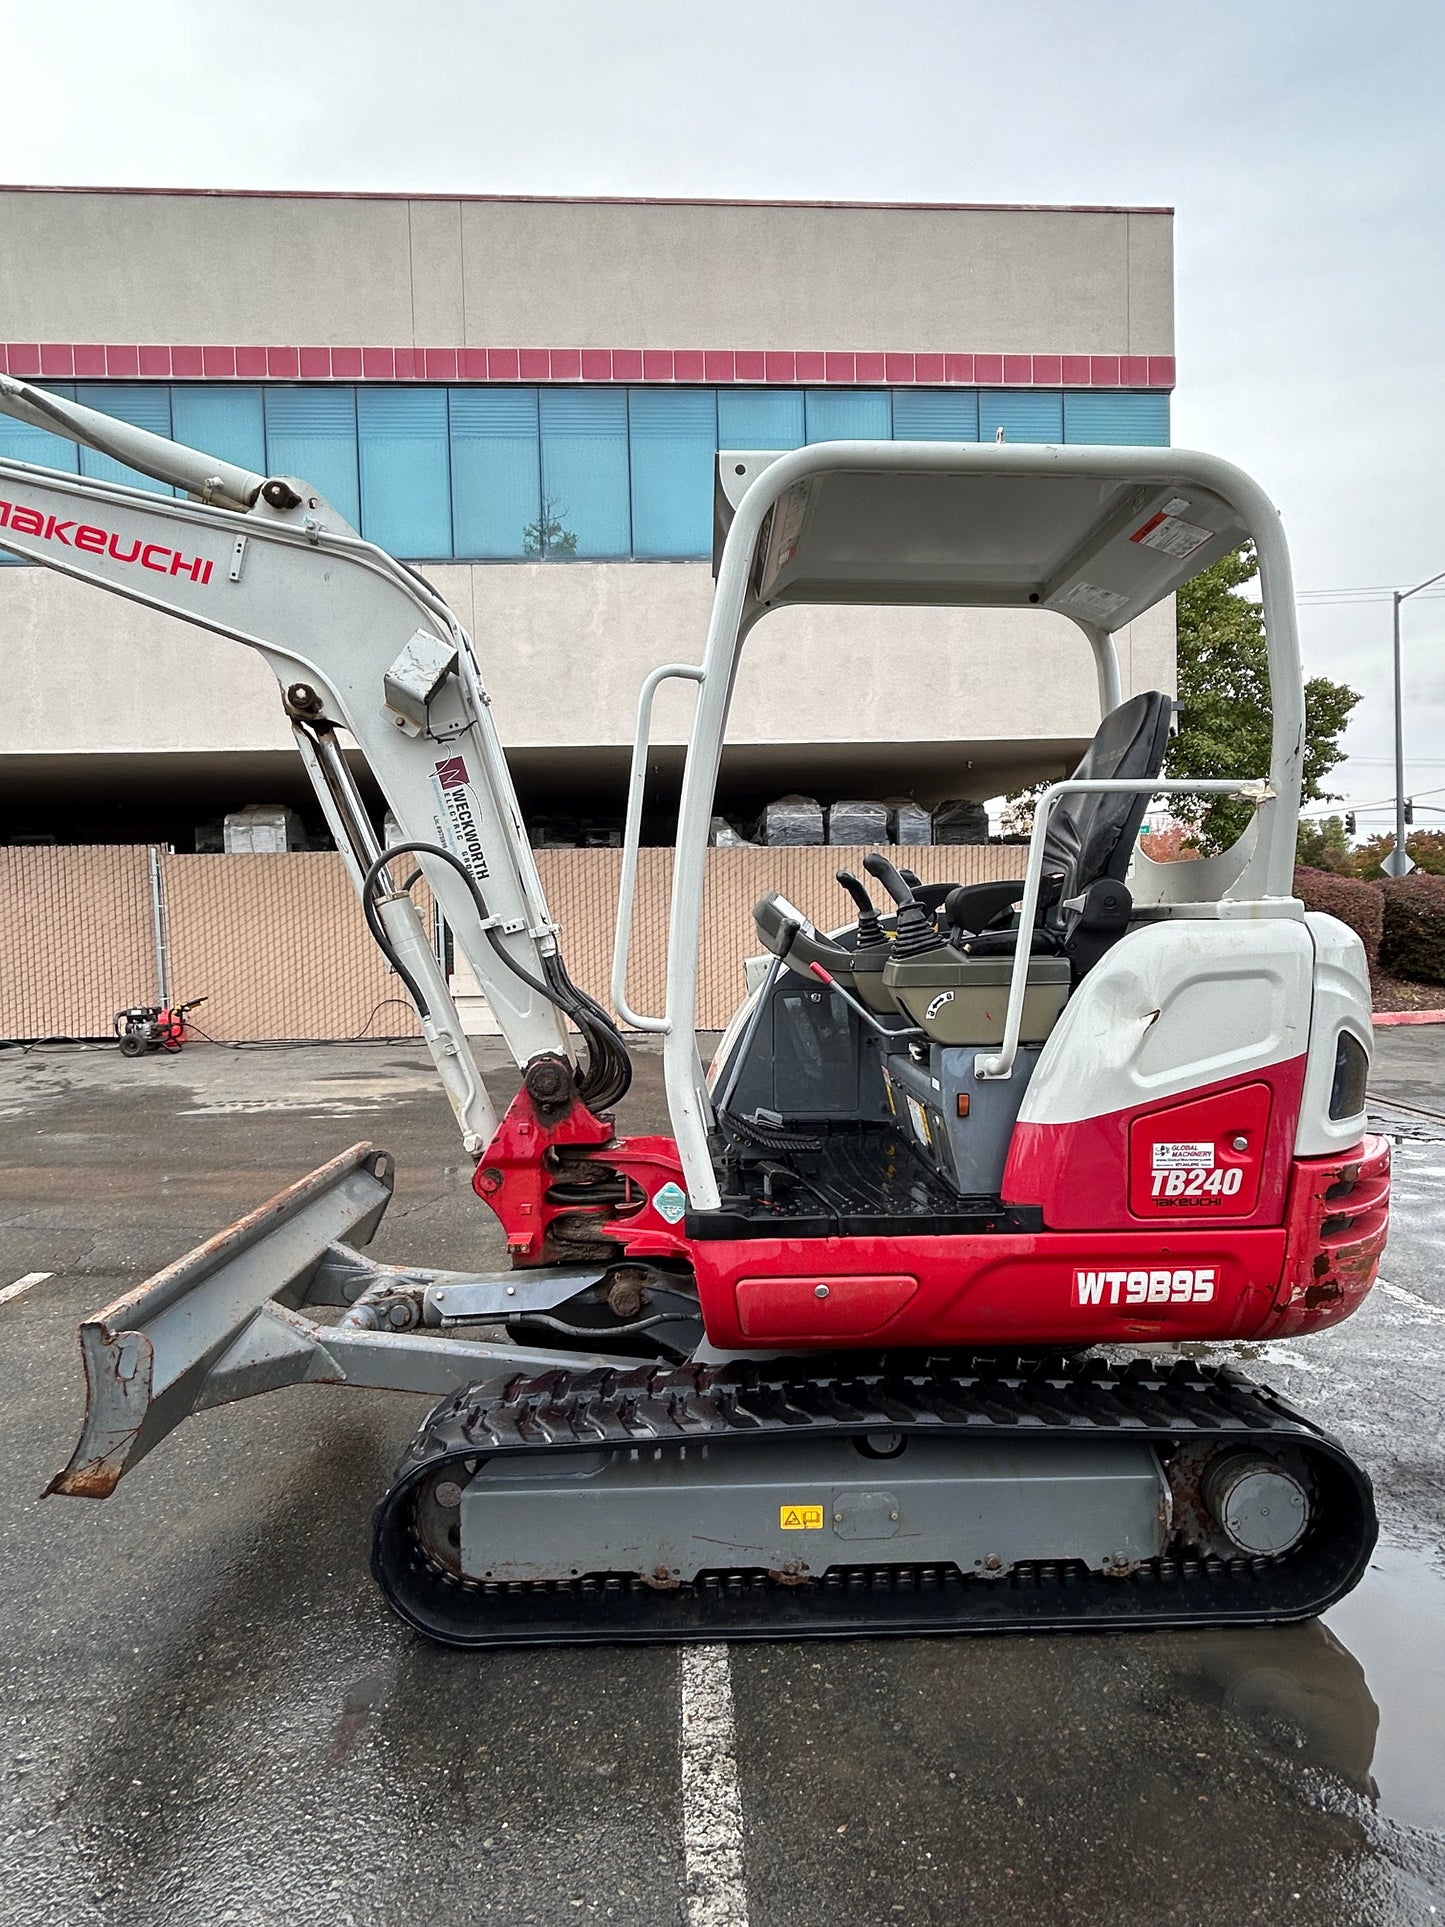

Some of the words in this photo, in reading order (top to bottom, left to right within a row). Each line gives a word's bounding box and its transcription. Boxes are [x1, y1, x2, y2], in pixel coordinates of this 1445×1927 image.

[443, 792, 464, 841] ELECTRIC
[452, 787, 490, 881] WECKWORTH
[1151, 1168, 1243, 1196] TB240
[1077, 1269, 1215, 1305] WT9B95
